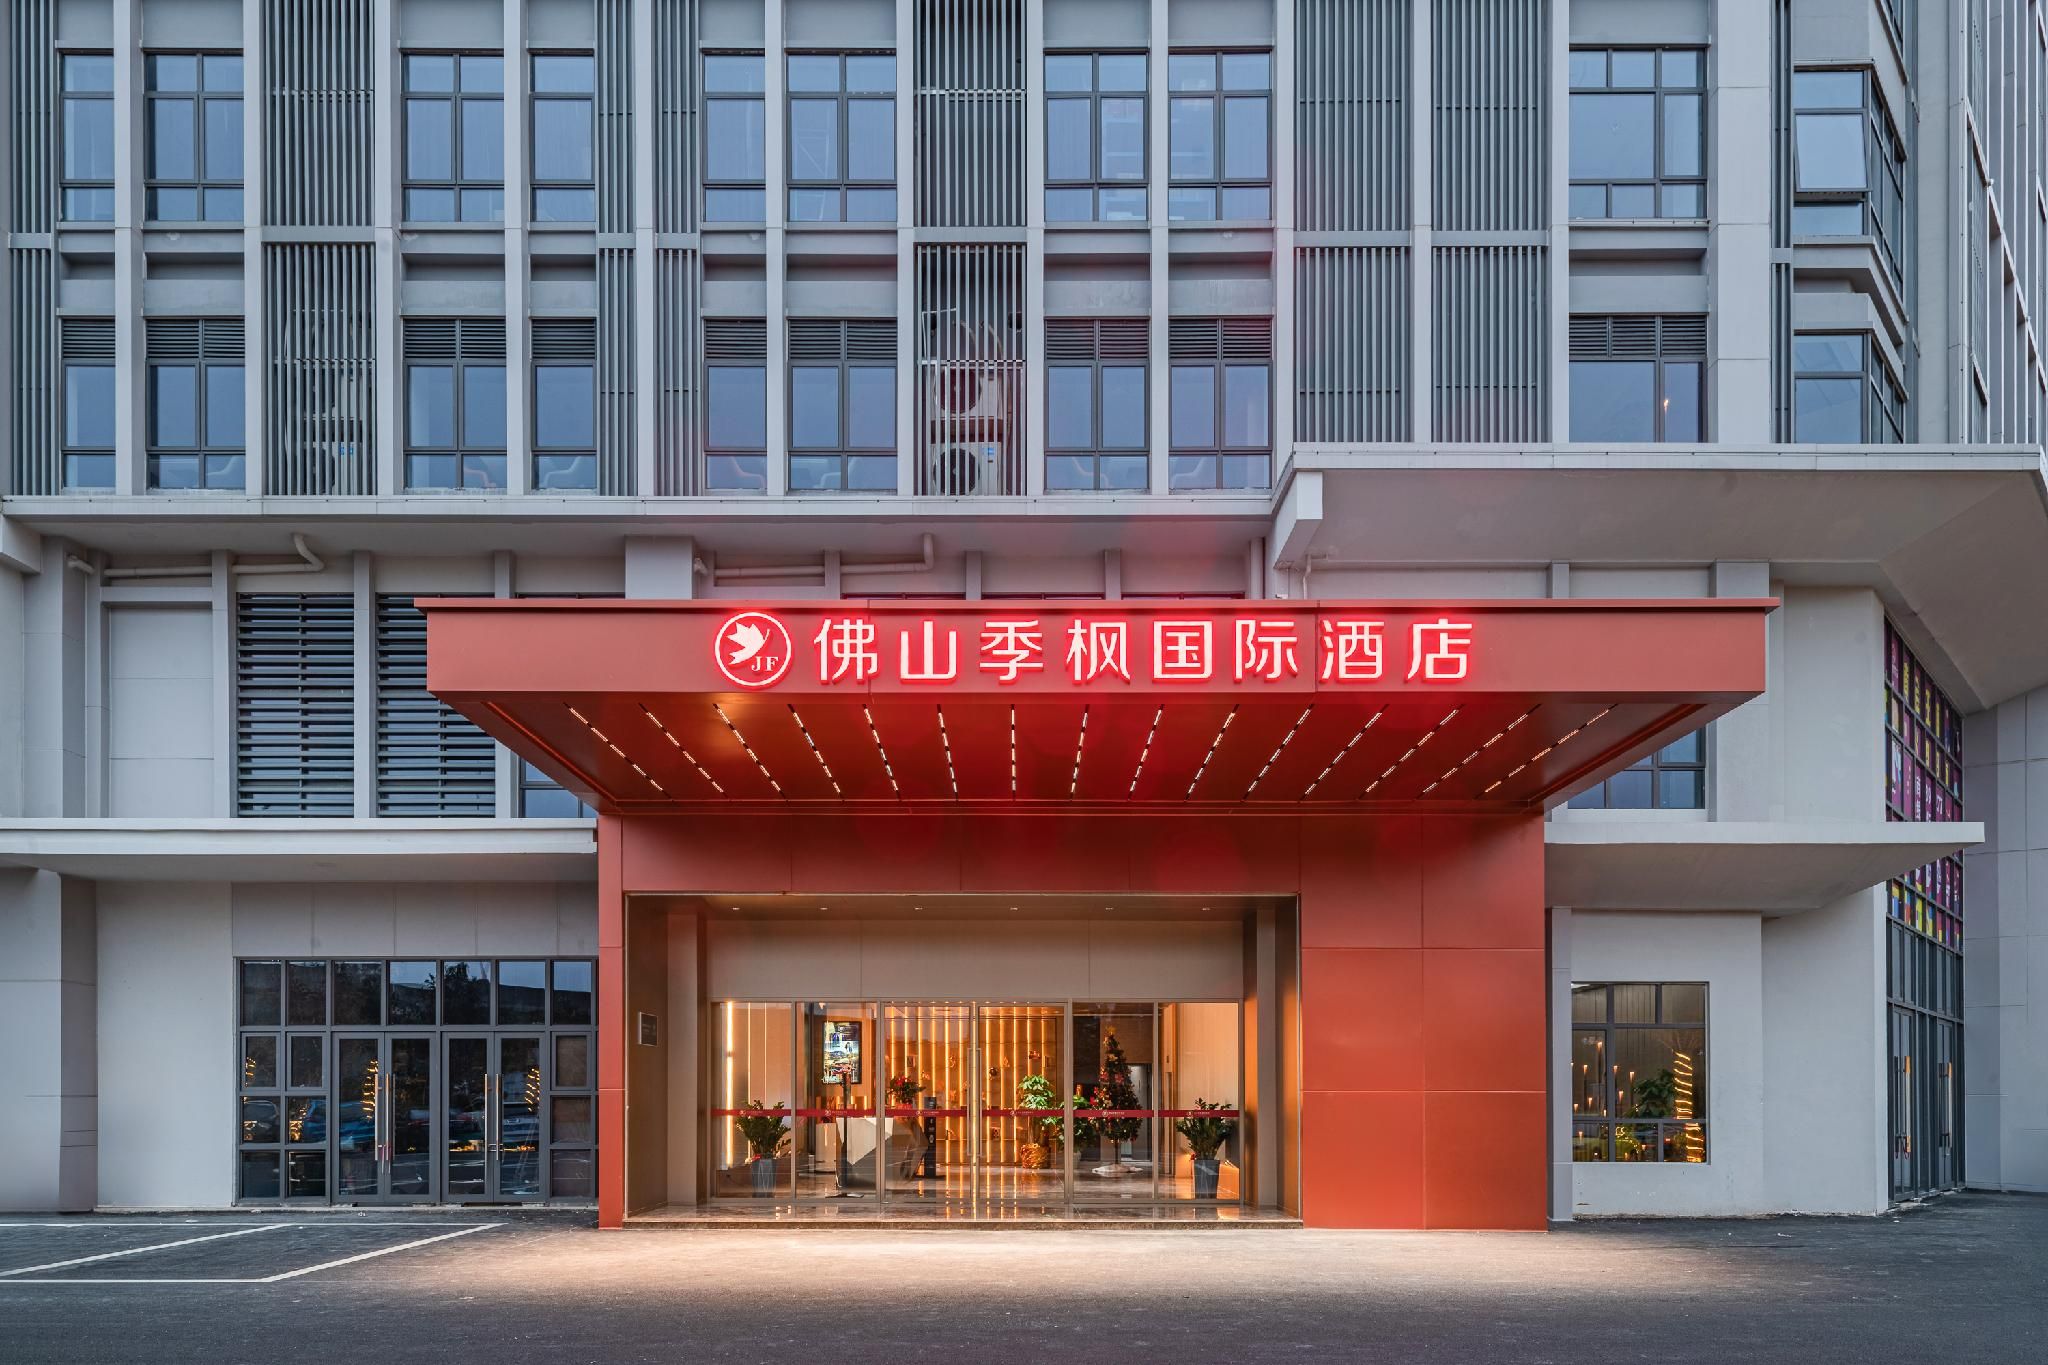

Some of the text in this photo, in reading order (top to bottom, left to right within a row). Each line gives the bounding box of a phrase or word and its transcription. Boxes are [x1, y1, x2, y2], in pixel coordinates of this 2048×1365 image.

[751, 656, 779, 672] JF
[813, 618, 1472, 683] 佛山季枫国际酒店
